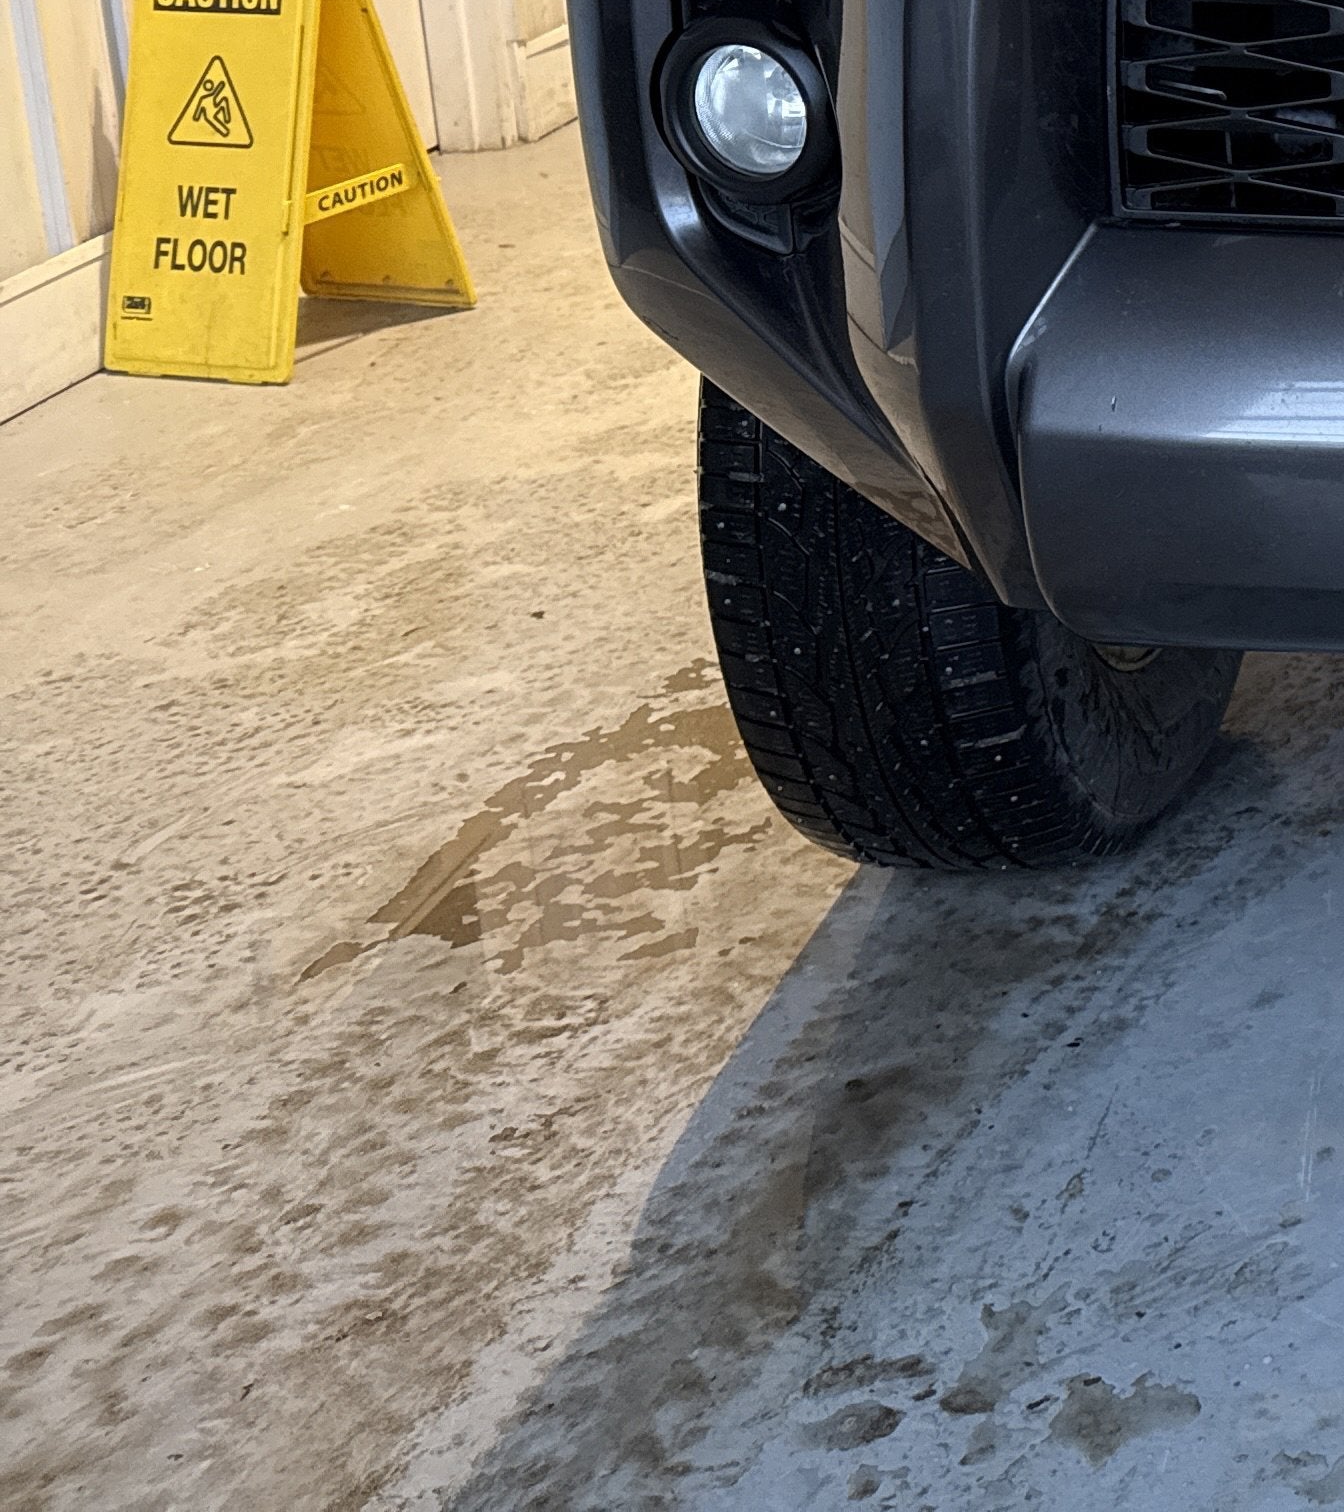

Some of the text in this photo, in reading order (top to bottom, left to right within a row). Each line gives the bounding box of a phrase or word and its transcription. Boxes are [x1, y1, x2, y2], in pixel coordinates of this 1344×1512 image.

[177, 185, 237, 221] WET
[317, 170, 403, 212] CAUTION
[153, 237, 248, 276] FLOOR
